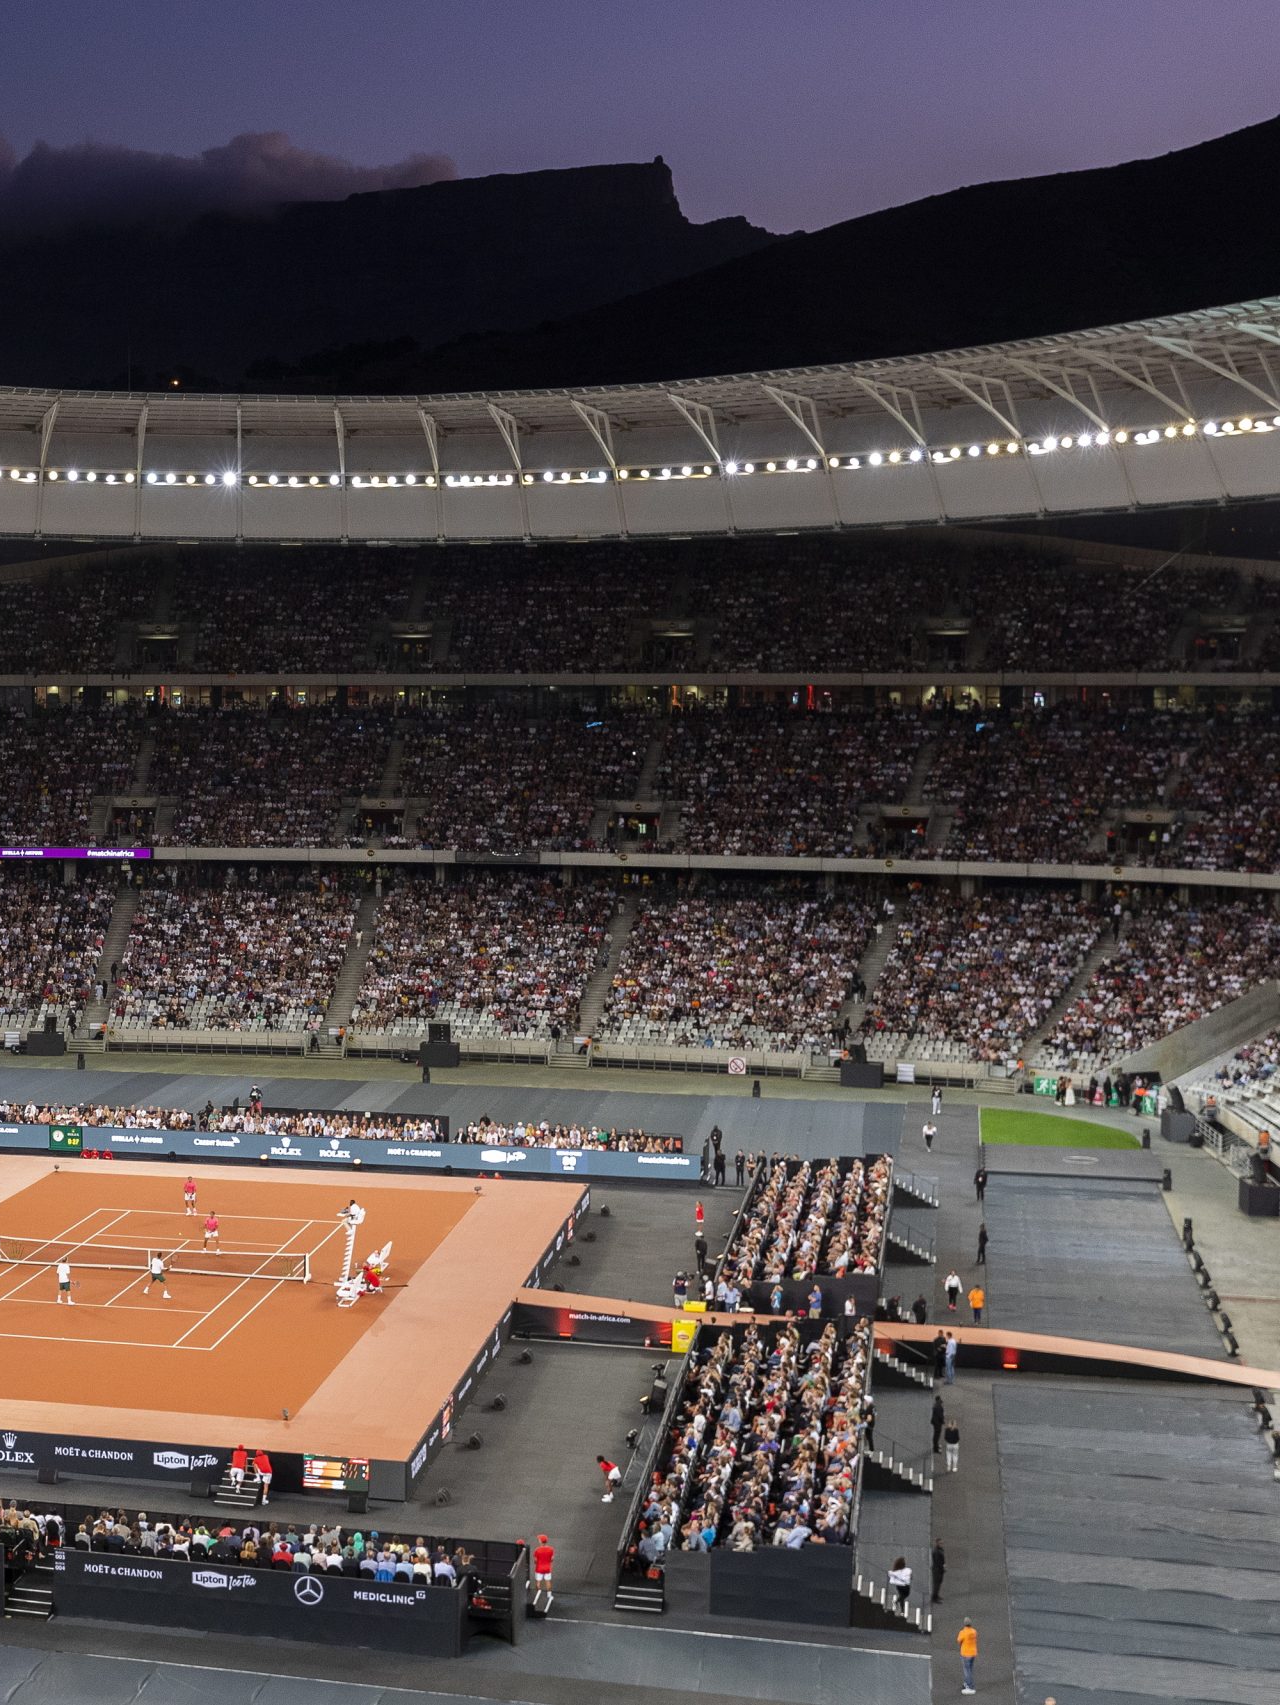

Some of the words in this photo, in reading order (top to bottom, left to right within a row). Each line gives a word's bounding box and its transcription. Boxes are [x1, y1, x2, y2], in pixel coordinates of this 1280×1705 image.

[271, 1147, 301, 1156] ROLEX
[320, 1150, 350, 1158] ROLEX
[569, 1313, 630, 1323] match-in-africa.com
[54, 1446, 80, 1457] MOËT
[88, 1449, 133, 1461] CHANDON
[156, 1454, 185, 1466] Lipton
[84, 1564, 109, 1574] MOËT
[118, 1567, 162, 1579] CHANDON
[195, 1573, 224, 1585] Lipton
[228, 1575, 242, 1590] Ice
[242, 1574, 256, 1586] Tea
[354, 1590, 414, 1605] MEDICLINIC
